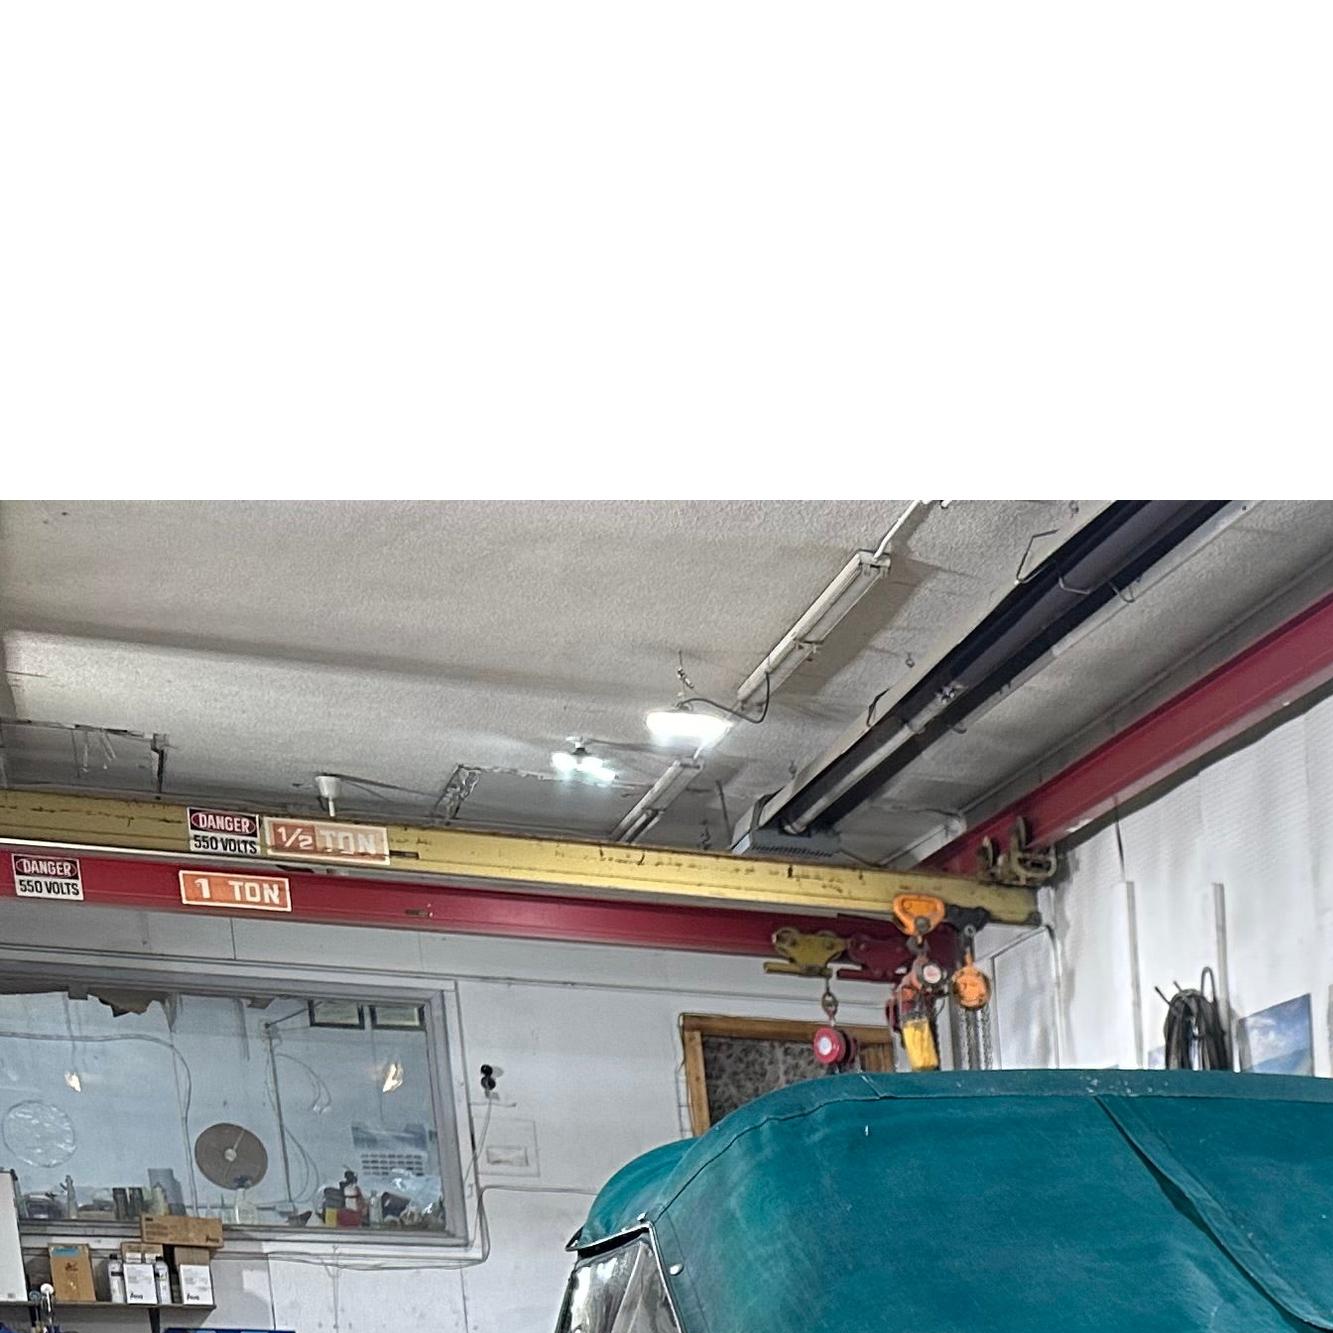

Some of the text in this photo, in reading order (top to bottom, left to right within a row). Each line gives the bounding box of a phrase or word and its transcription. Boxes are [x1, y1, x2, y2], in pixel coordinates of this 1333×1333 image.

[199, 813, 251, 833] DANGER
[193, 835, 258, 854] 550 VOLTS
[276, 825, 378, 855] 1/2 TON
[22, 858, 72, 877] DANGER
[19, 879, 80, 896] 550 VOLTS
[194, 878, 280, 904] 1 TON
